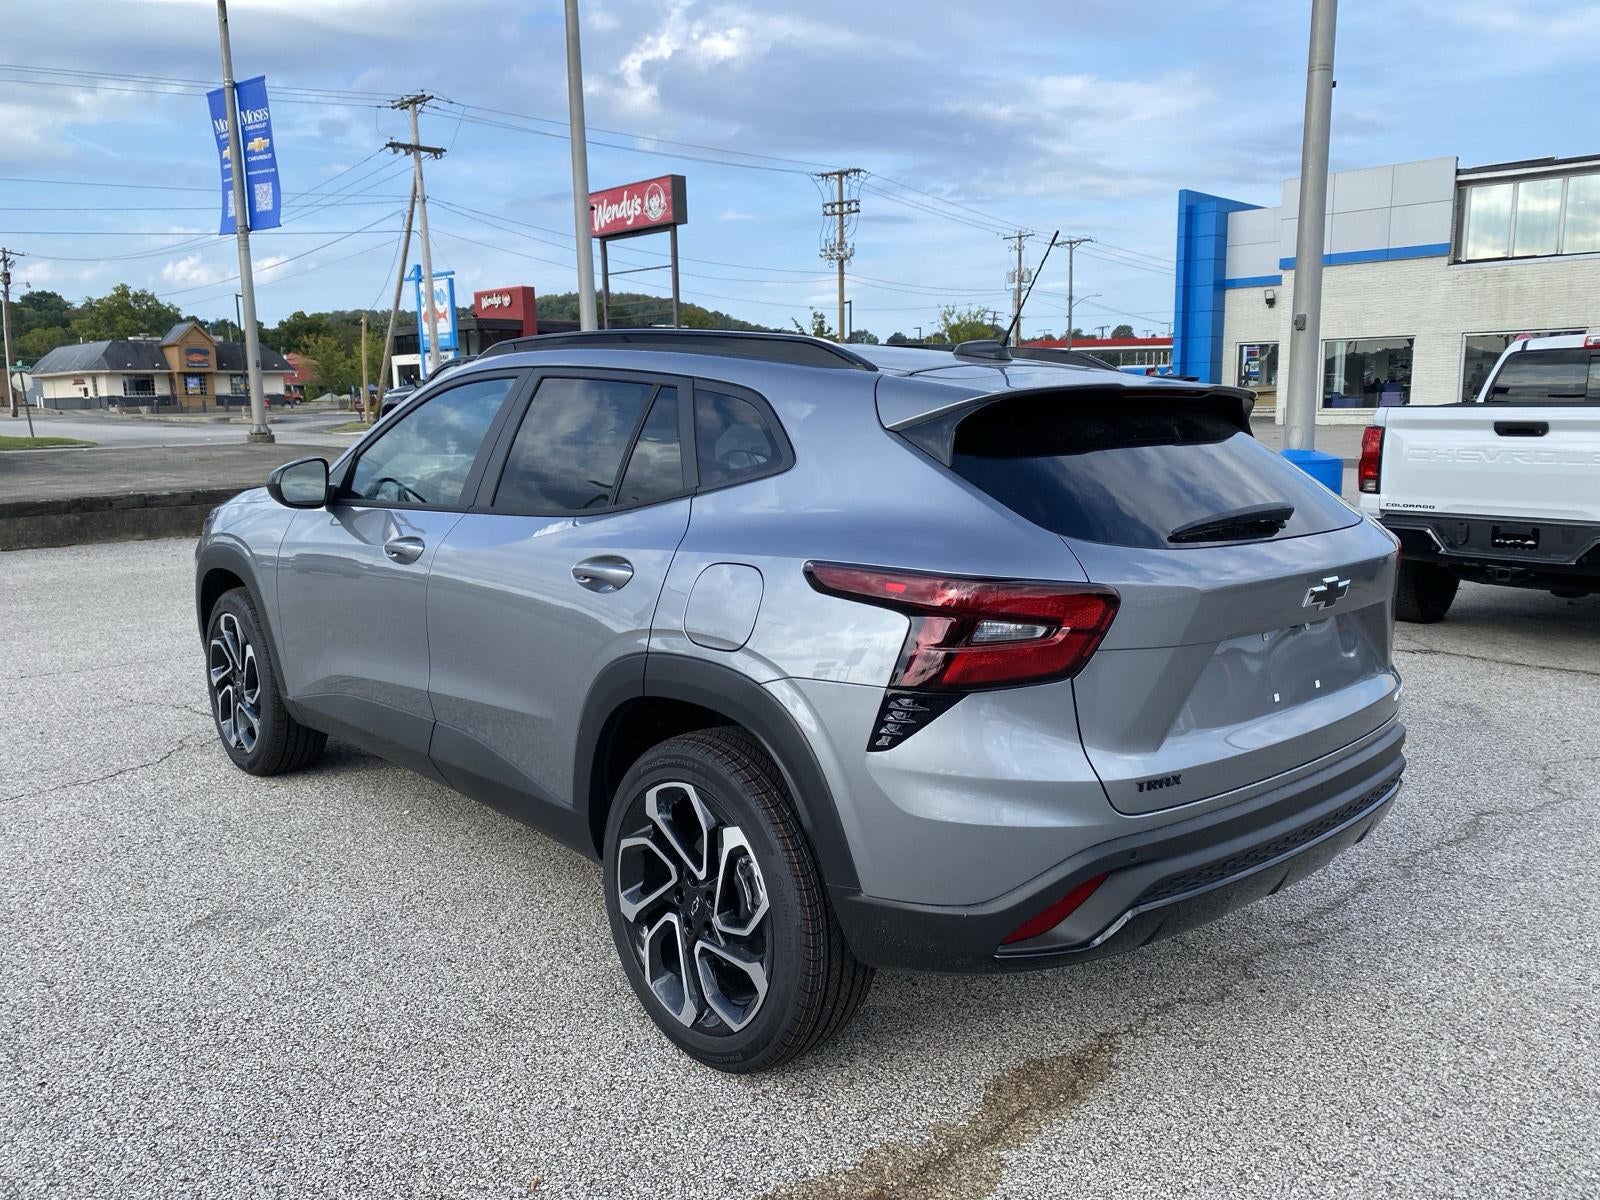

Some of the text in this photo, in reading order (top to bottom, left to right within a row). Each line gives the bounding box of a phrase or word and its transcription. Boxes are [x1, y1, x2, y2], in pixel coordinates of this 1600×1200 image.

[240, 107, 269, 126] MOSES
[593, 190, 642, 232] Wendy's
[1385, 502, 1435, 510] COLORADO
[1135, 773, 1182, 792] TRAX
